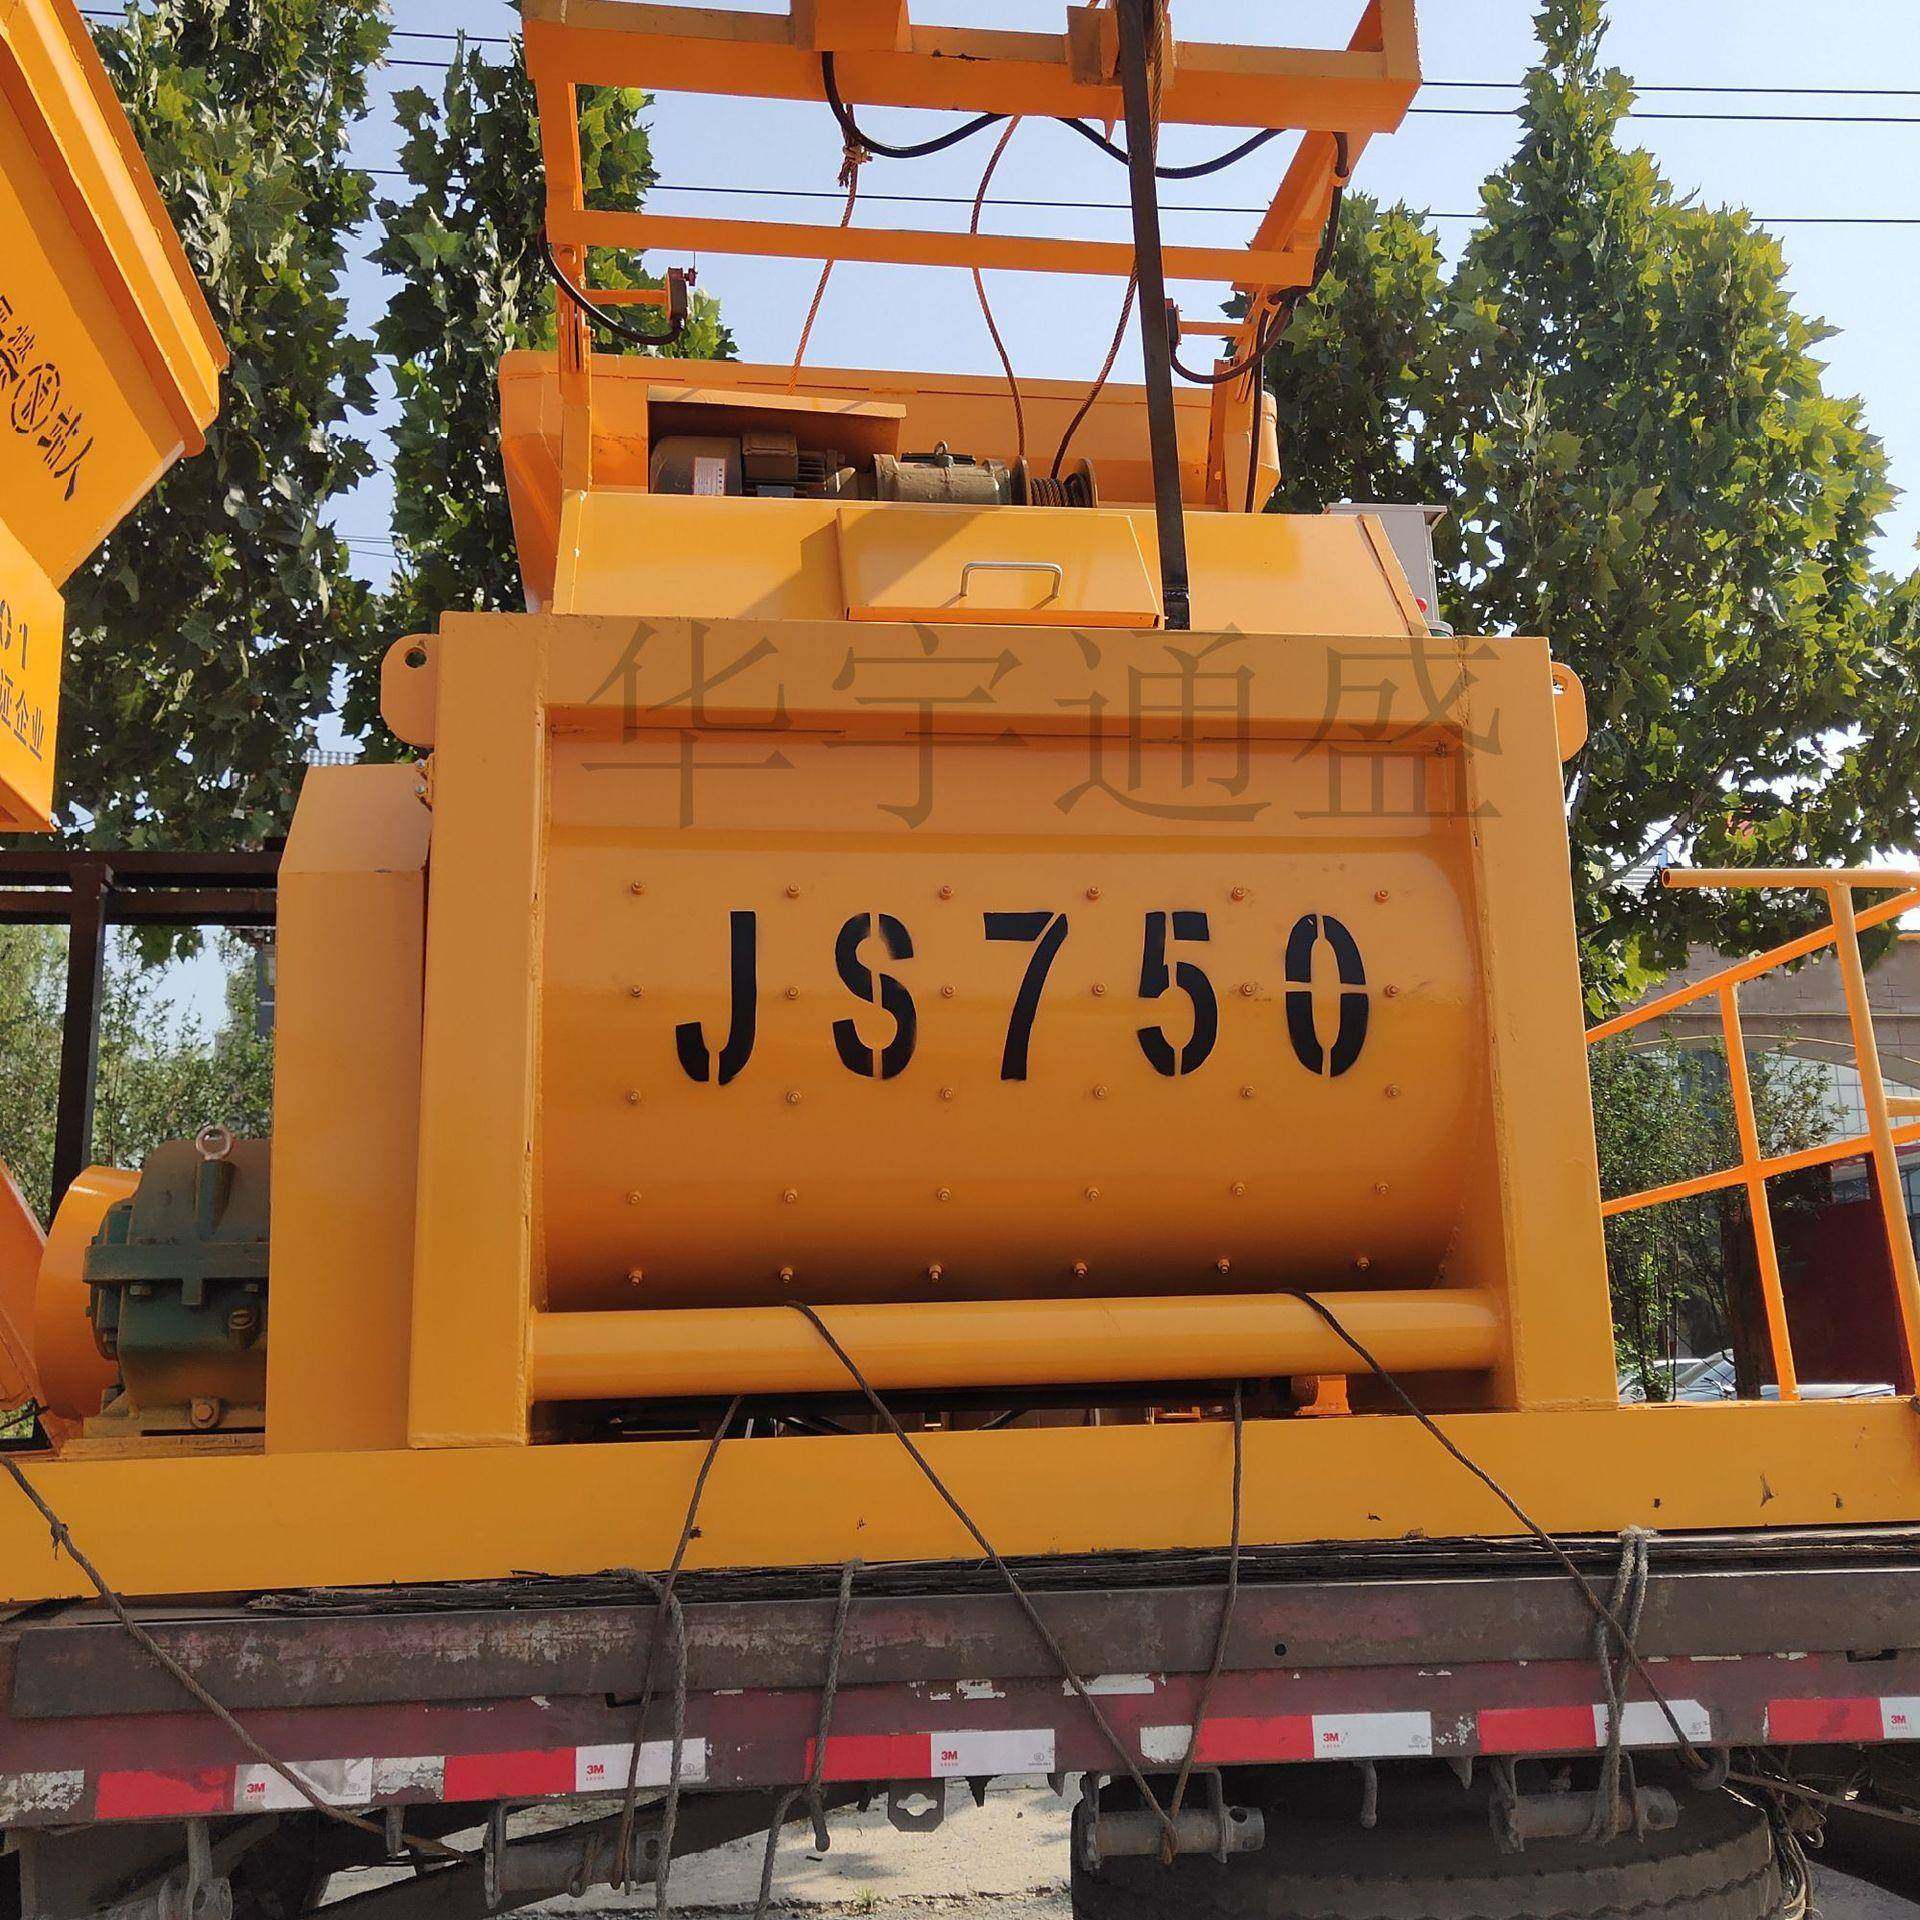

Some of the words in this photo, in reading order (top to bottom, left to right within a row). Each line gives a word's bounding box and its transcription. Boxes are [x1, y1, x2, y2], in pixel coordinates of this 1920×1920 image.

[675, 911, 1369, 1086] JS750
[1891, 1715, 1907, 1724] 3M
[1323, 1732, 1339, 1742] 3M
[941, 1750, 958, 1760] 3M
[586, 1764, 604, 1775] 3M
[246, 1782, 266, 1793] 3M
